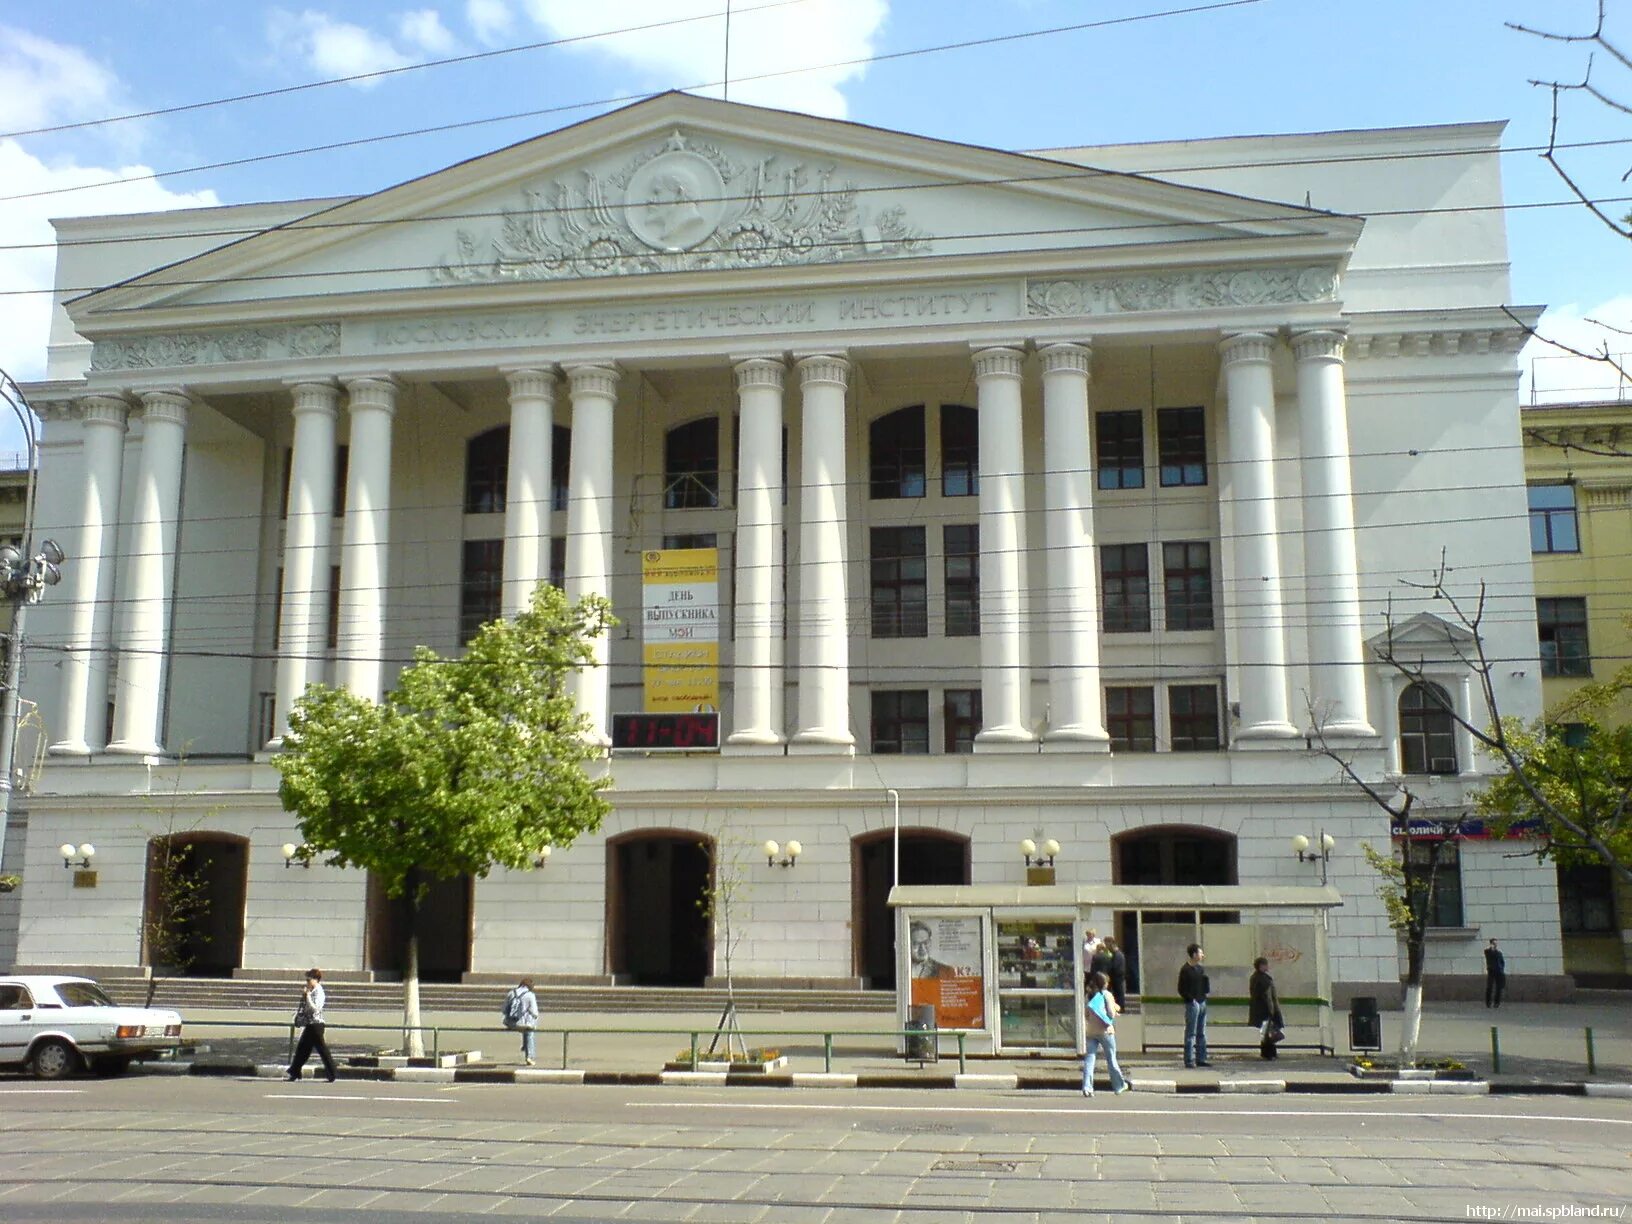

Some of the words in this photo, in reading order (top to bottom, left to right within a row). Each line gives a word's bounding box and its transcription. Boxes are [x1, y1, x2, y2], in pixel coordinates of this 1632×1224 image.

[838, 291, 998, 320] ИНСТИТУТ
[668, 590, 694, 602] ДЕНЬ
[647, 608, 715, 620] ВЫПУСКНИКА
[627, 717, 713, 746] 11-04
